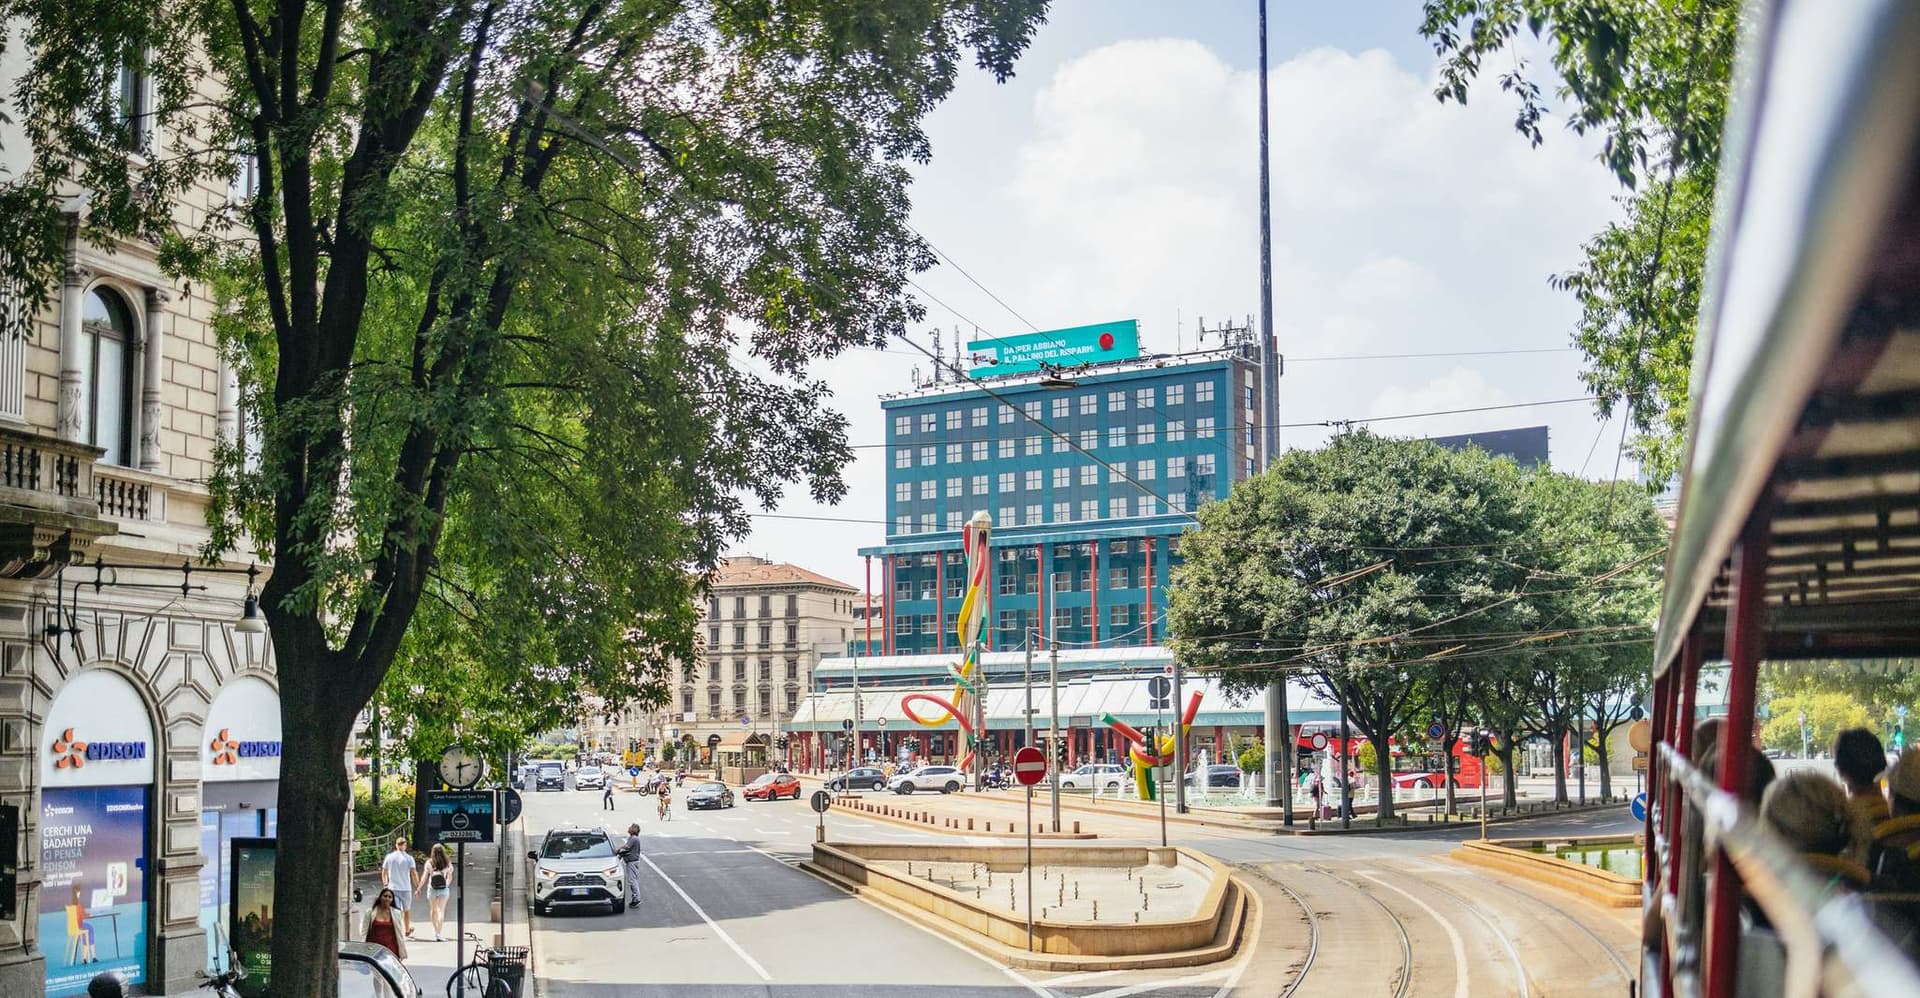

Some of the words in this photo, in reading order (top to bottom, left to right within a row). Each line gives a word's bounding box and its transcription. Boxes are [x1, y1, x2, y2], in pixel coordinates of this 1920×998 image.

[1032, 340, 1066, 350] ABBIAMO
[1044, 350, 1059, 358] DEL
[43, 825, 72, 838] CERCHI
[74, 824, 93, 836] UNA
[43, 837, 86, 850] BADANTE?
[44, 850, 51, 861] CI
[54, 848, 82, 860] PENSA
[44, 860, 75, 872] EDISON
